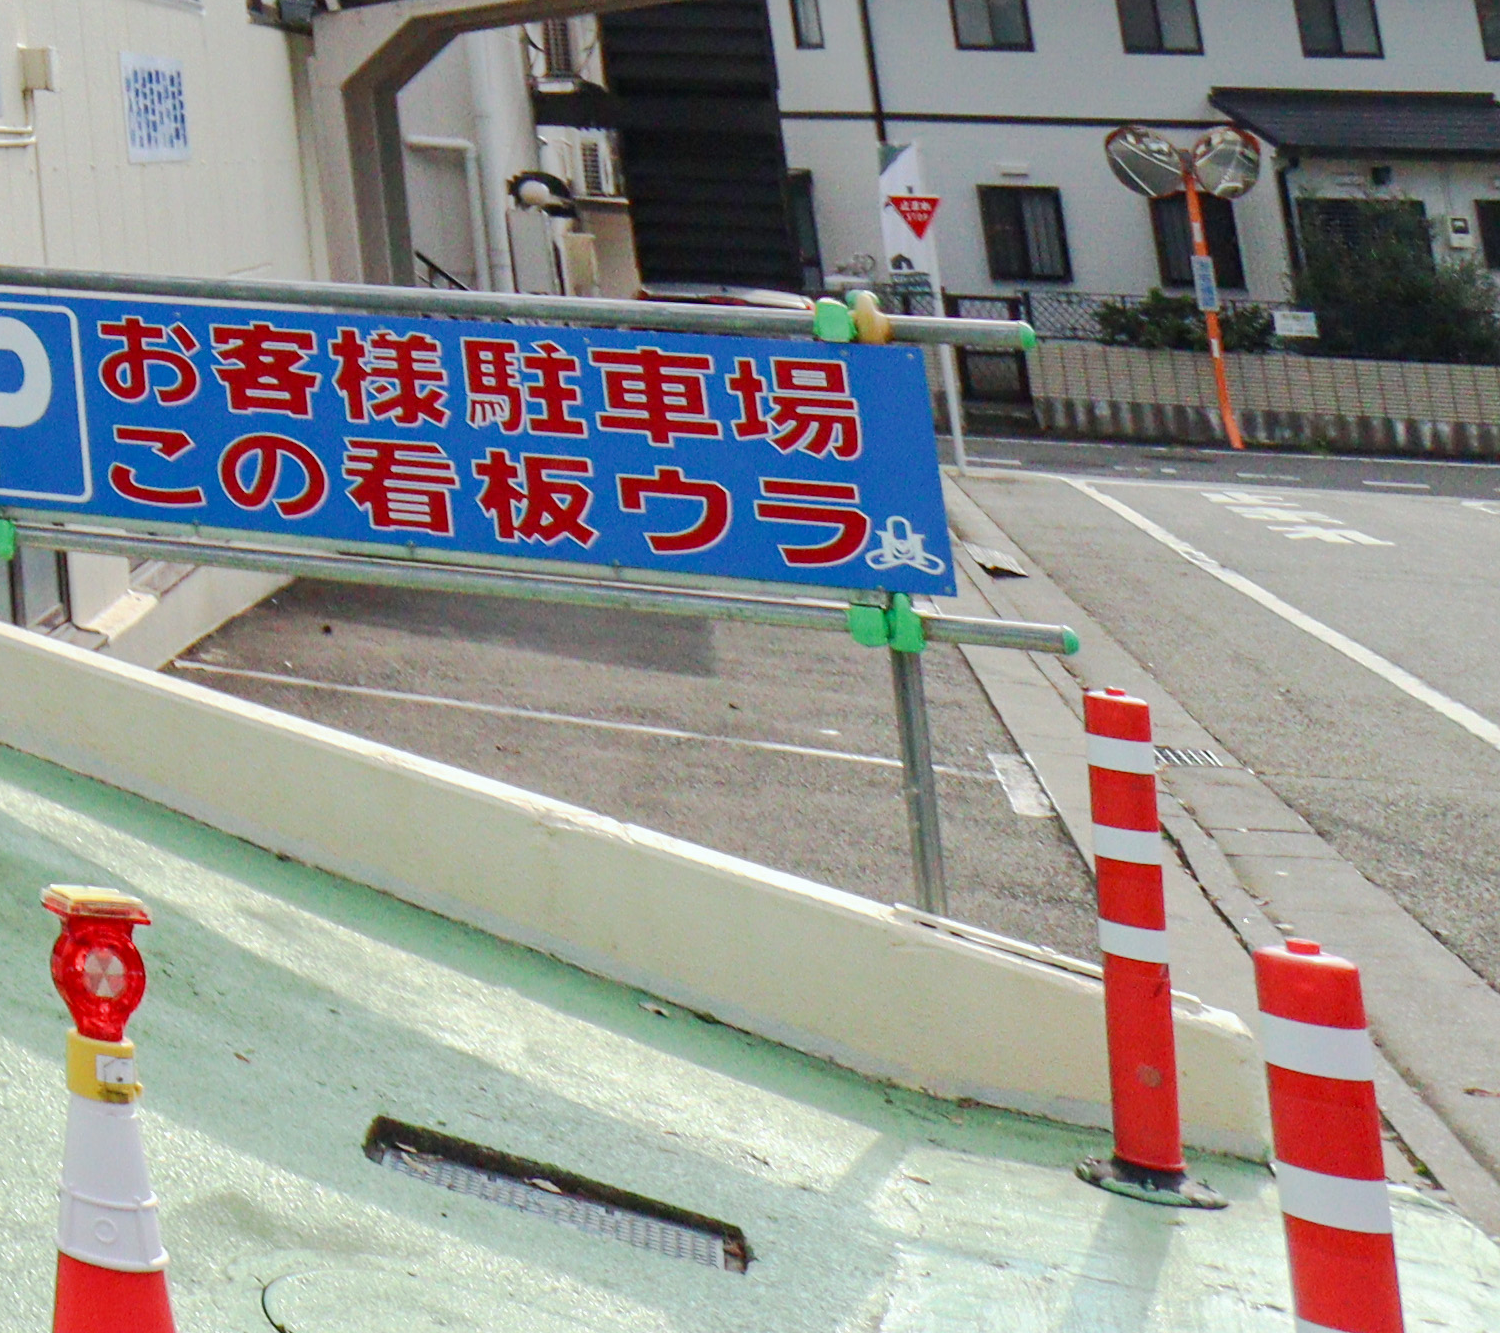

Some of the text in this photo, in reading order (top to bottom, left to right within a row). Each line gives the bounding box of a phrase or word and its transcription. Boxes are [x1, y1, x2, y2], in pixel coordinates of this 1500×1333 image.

[98, 314, 863, 461] お客様駐車場
[108, 423, 872, 568] この看板ウラ
